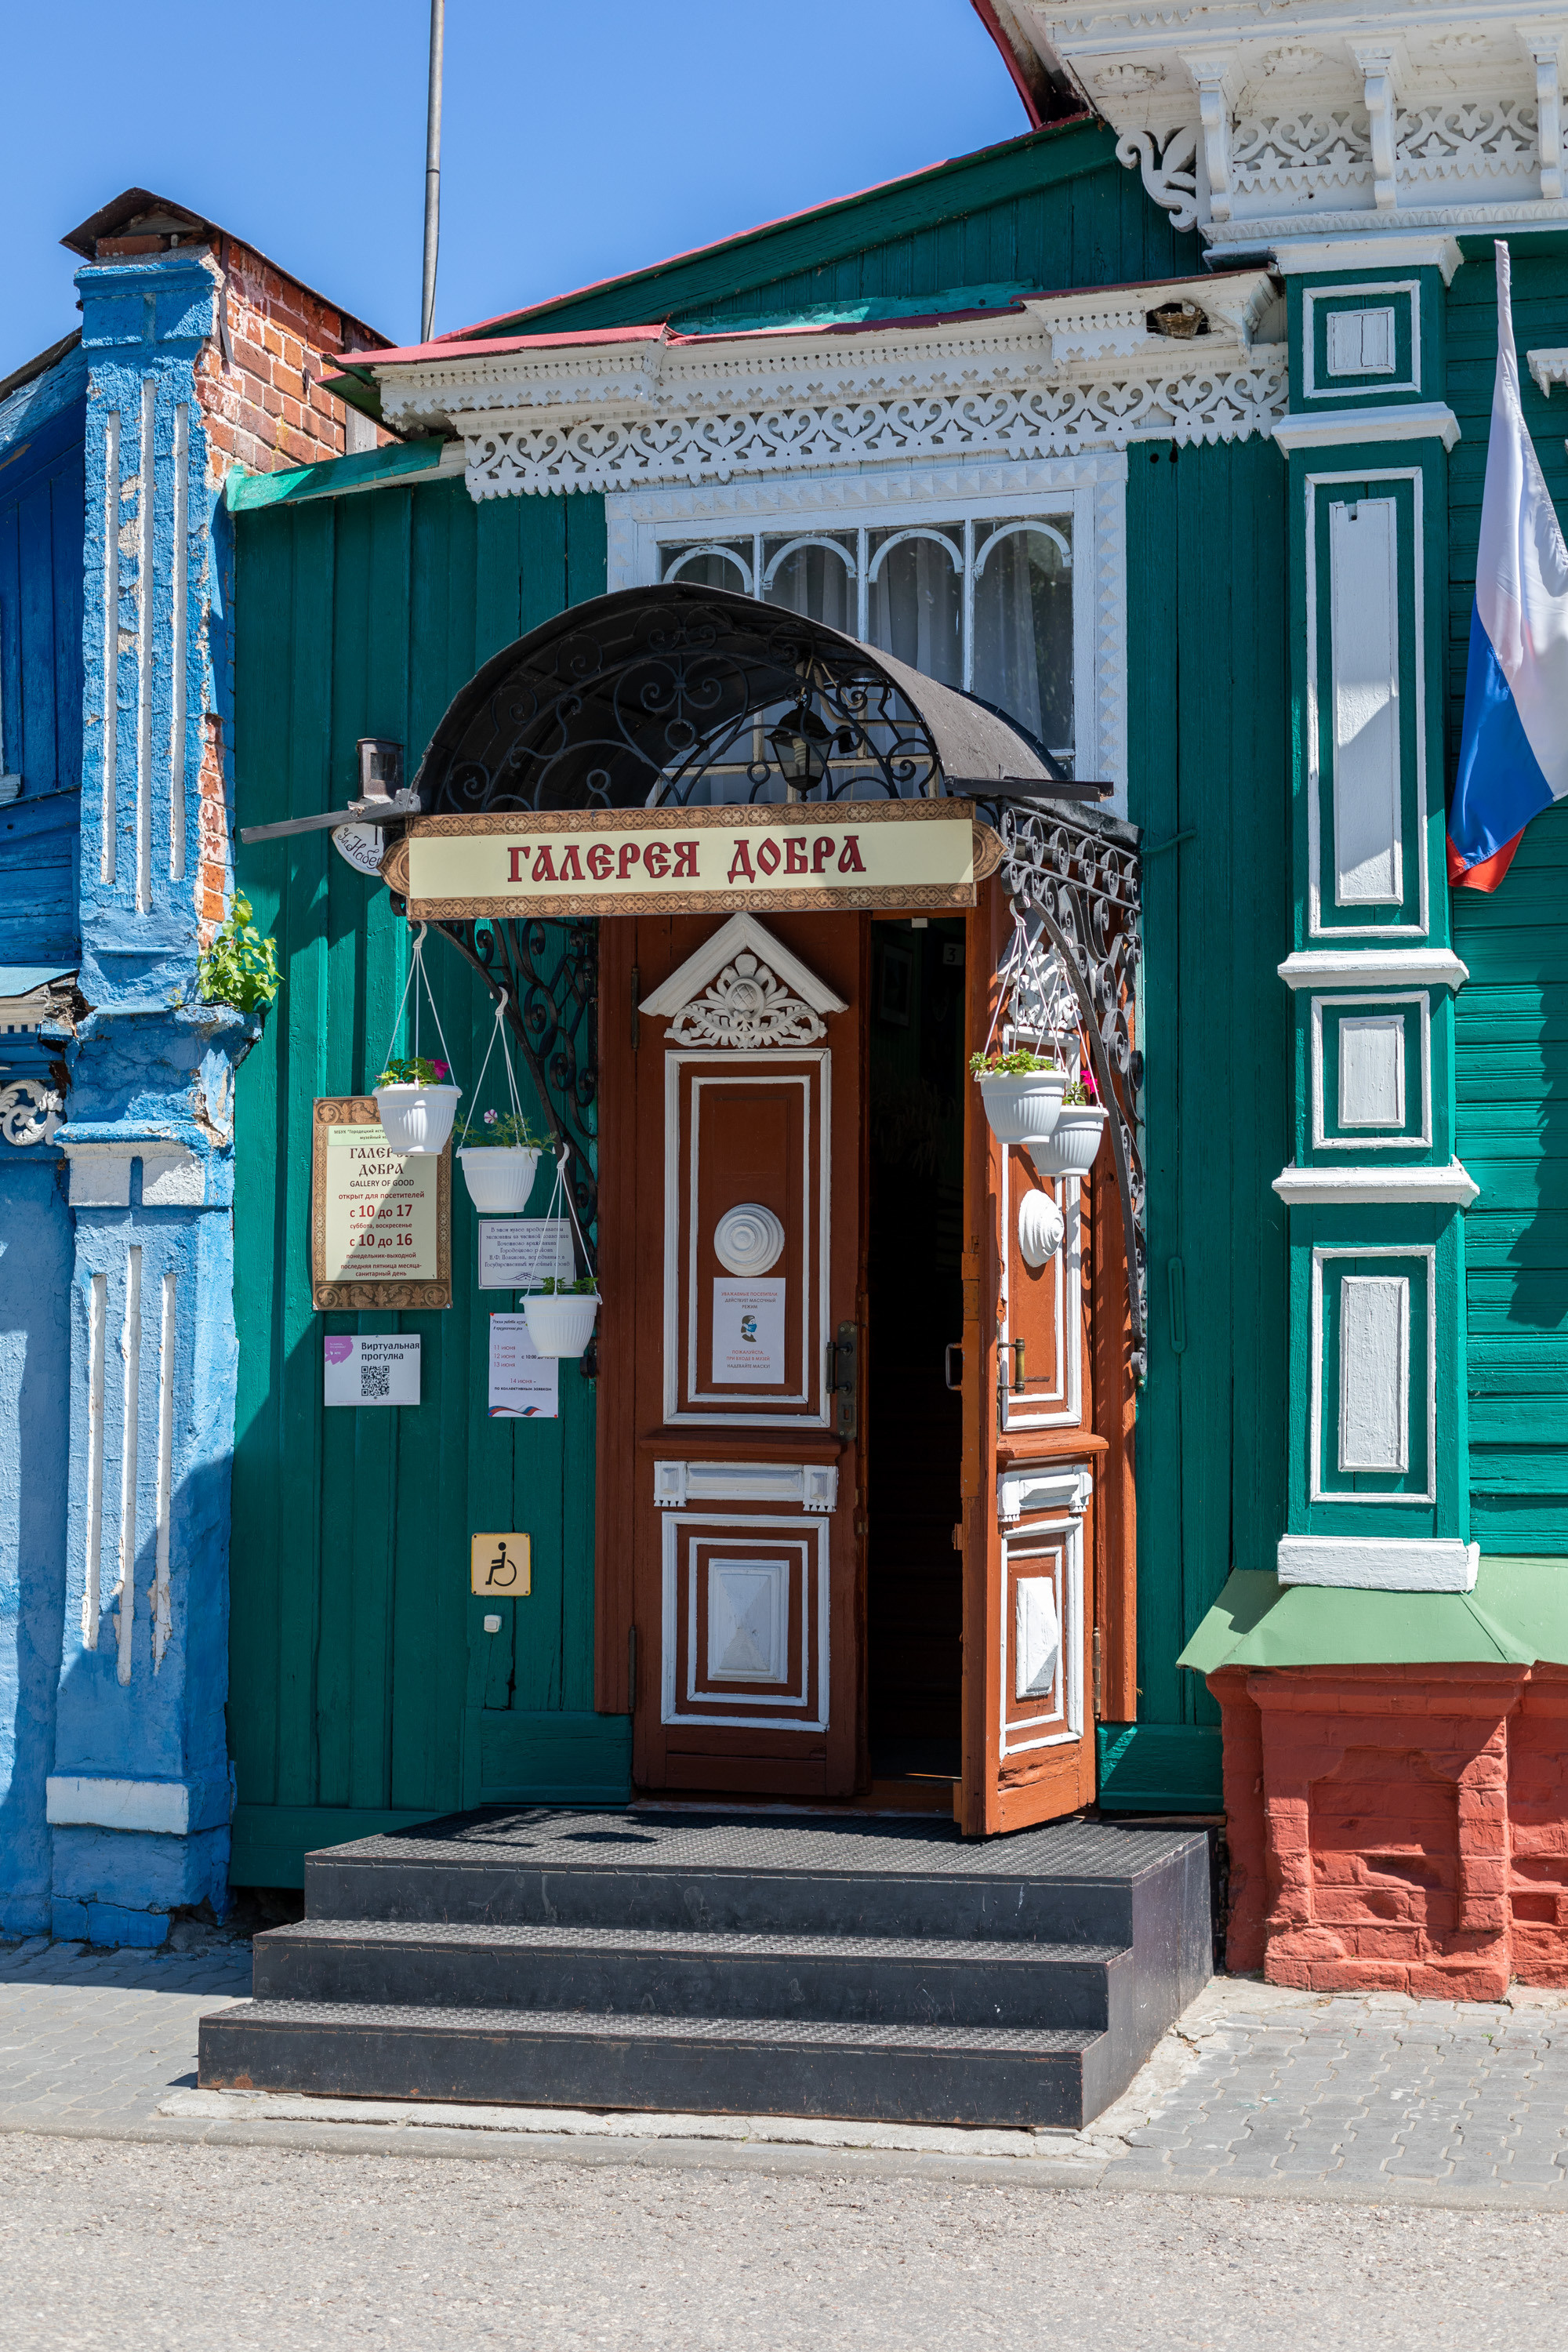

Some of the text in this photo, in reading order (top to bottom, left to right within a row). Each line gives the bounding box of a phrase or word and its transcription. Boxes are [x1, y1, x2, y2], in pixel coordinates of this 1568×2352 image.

[506, 835, 867, 884] ГАЛЕРЕЯ ДОБРА
[350, 1147, 415, 1159] ГАЛЕР
[358, 1163, 405, 1177] ДОБРА
[359, 1205, 375, 1218] 10
[378, 1209, 393, 1219] до
[396, 1204, 412, 1217] 17
[358, 1234, 375, 1247] 10
[378, 1238, 393, 1248] до
[396, 1233, 412, 1246] 16
[361, 1342, 419, 1351] Виртуальная
